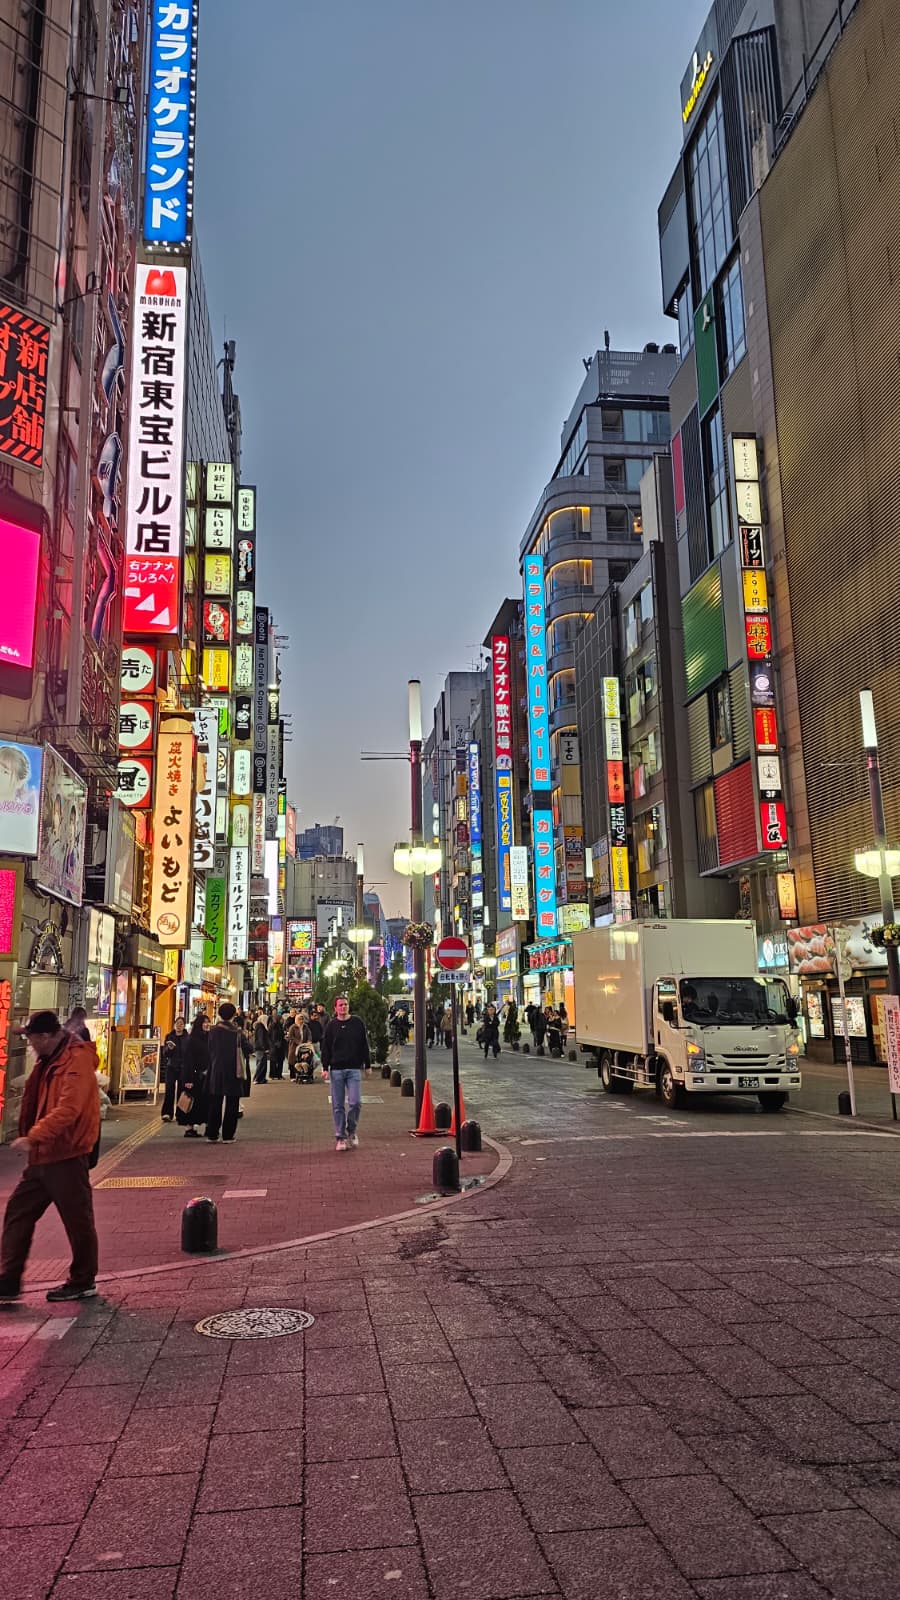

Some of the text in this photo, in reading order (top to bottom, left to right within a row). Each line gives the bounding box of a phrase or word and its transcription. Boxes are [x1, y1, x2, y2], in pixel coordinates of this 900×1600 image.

[150, 3, 191, 229] カラオケランド
[140, 296, 182, 307] MARUHAN
[12, 331, 49, 451] 新店舗
[134, 311, 177, 553] 新宿東宝ビル店
[213, 464, 226, 500] 川新ビル
[129, 561, 174, 571] 右ナナメ
[748, 529, 760, 559] ダーツ
[748, 623, 768, 653] 麻雀
[166, 741, 182, 796] 炭火焼き
[161, 805, 182, 903] よいもど
[537, 820, 555, 926] カラオケ館
[232, 884, 244, 931] ルノアール
